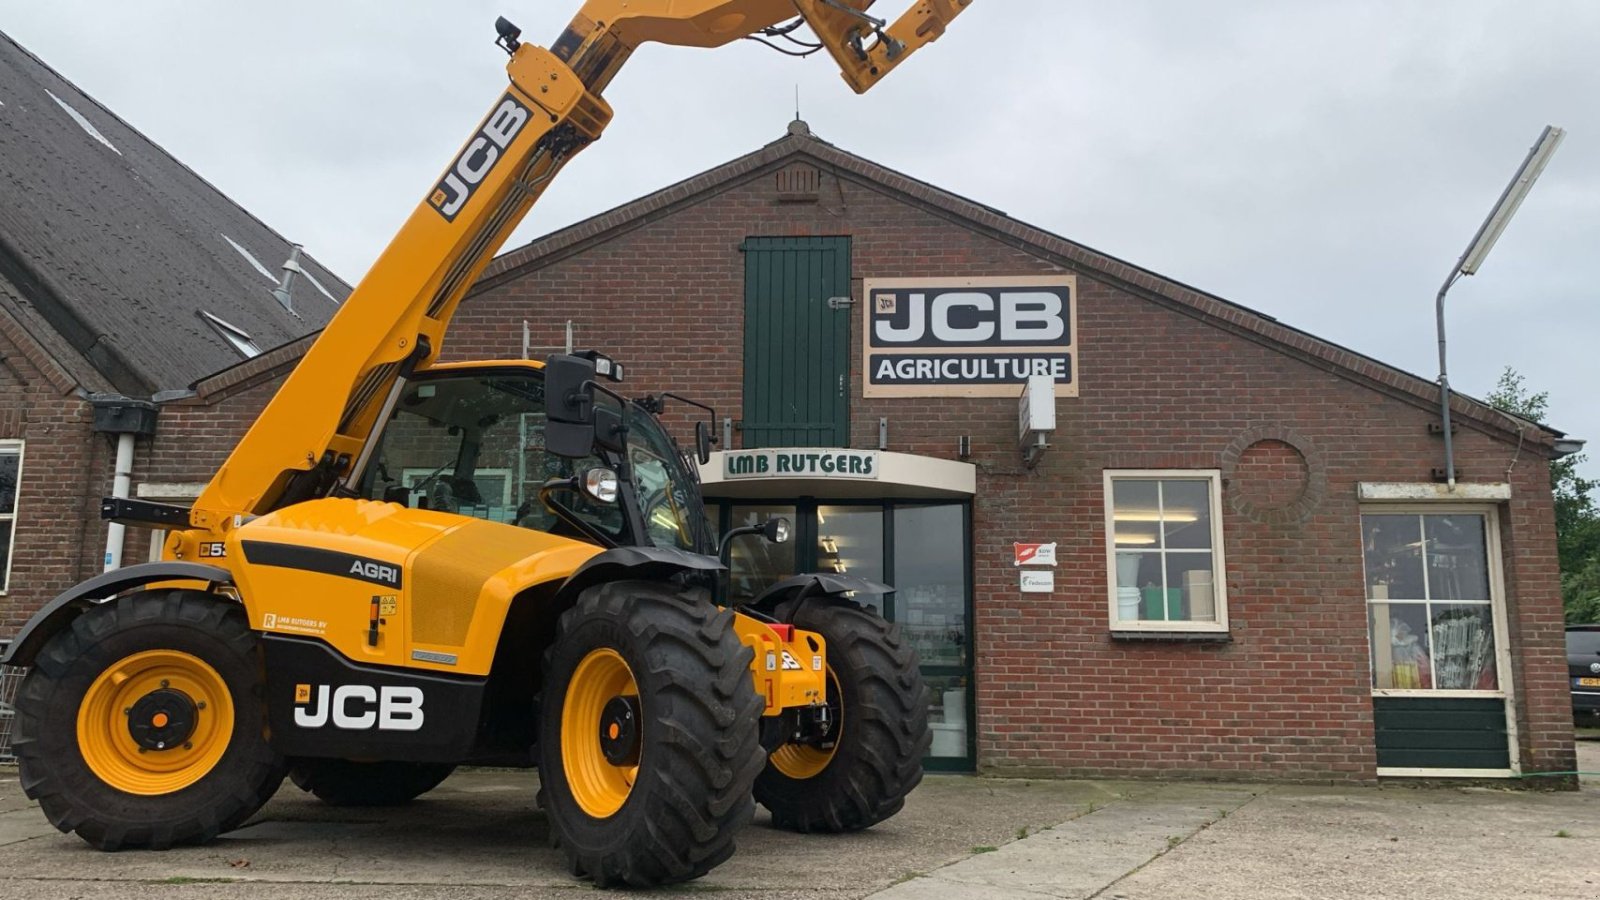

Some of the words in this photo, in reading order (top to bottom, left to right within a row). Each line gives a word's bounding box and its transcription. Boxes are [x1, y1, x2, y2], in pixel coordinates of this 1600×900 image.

[441, 99, 528, 216] JCB
[875, 292, 1065, 342] JCB
[875, 358, 1067, 380] AGRICULTURE
[728, 454, 769, 475] LMB
[777, 453, 873, 475] RUTGERS
[349, 560, 398, 583] AGRI
[294, 684, 425, 731] JCB
